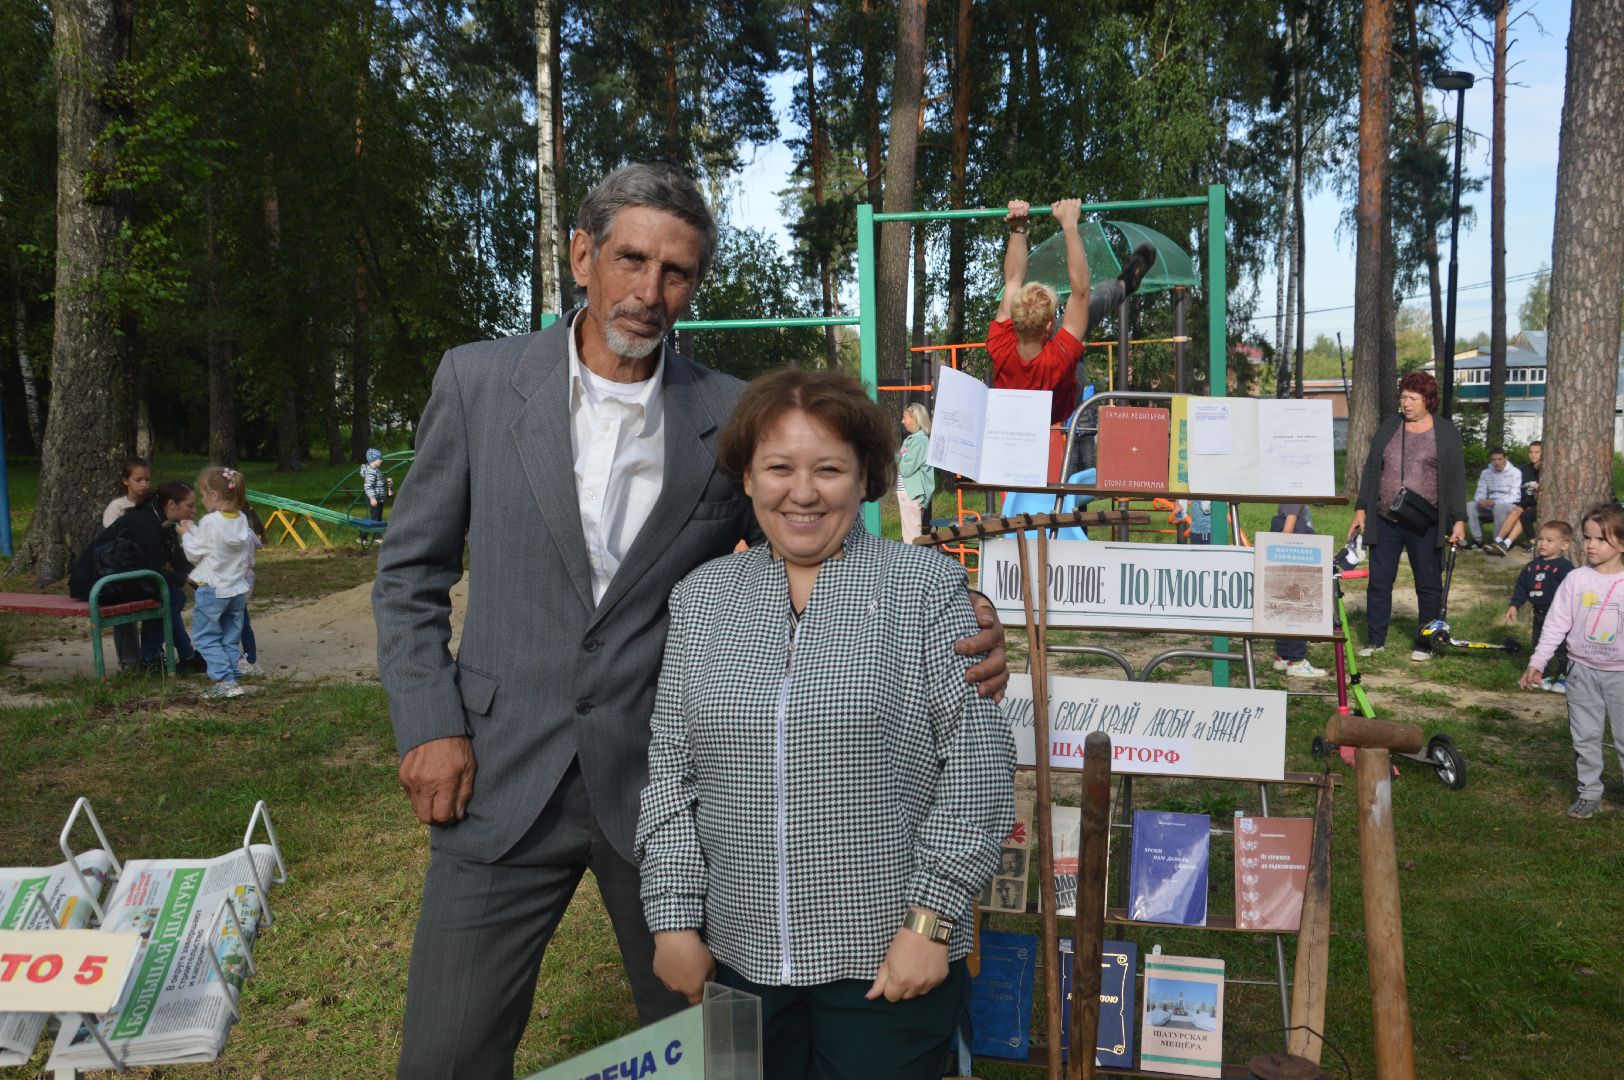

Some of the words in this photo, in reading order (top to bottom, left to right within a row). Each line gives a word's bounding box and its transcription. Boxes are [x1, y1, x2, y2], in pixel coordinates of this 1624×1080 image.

[1105, 411, 1129, 419] ТАМАРА
[1131, 412, 1166, 420] ЛЕОНТЬЕВА
[1104, 479, 1126, 488] ВТОРАЯ
[1128, 480, 1165, 489] ПРОГРАММА
[1119, 562, 1254, 611] ПОДМОСКОВ
[1054, 698, 1098, 732] СВОЙ
[1099, 702, 1140, 734] КРАЙ
[1142, 707, 1195, 739] ЛЮБИ
[1052, 742, 1180, 765] ШАРТОРФ
[128, 938, 174, 1026] БОЛЬШАЯ
[163, 872, 200, 939] ШАТУРА
[172, 954, 186, 982] округе
[184, 910, 202, 954] завершают
[178, 929, 204, 990] строительство
[74, 955, 108, 985] 5
[1154, 1030, 1208, 1041] ШАТУРСКАЯ
[1160, 1040, 1202, 1050] МЕЩЁРА
[581, 1050, 657, 1080] ЕЧА
[664, 1040, 682, 1066] С
